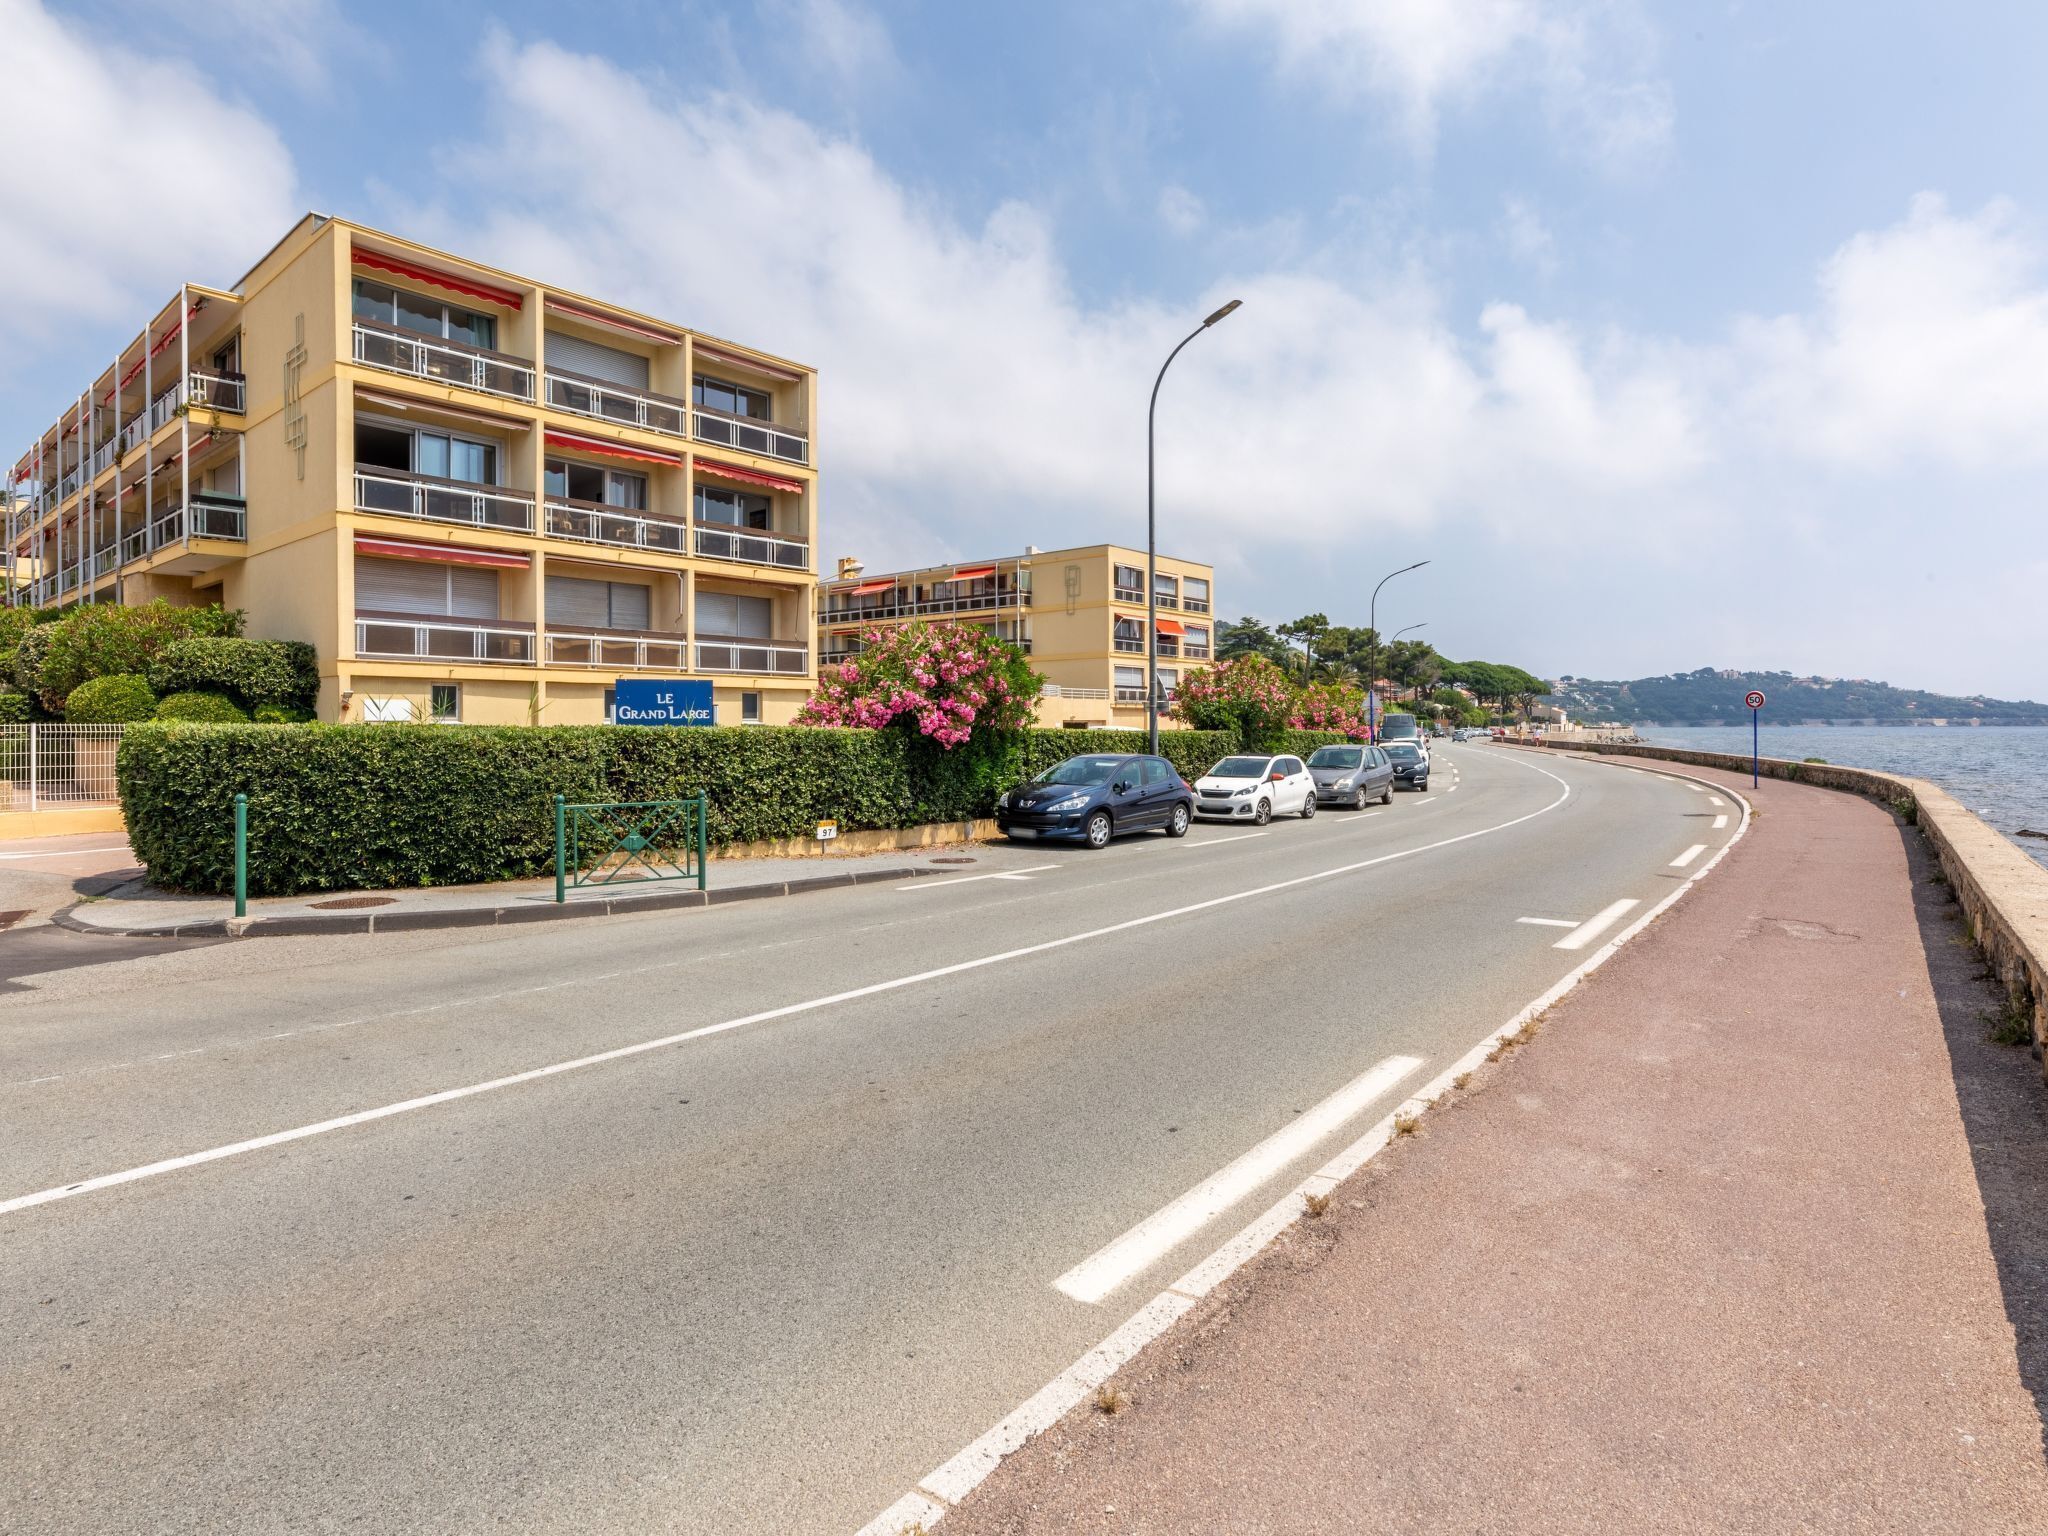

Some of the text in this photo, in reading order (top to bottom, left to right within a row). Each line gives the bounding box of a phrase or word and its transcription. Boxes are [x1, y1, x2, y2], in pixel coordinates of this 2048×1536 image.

[656, 693, 674, 704] LE
[1749, 696, 1761, 704] 50
[618, 705, 710, 720] GRAND LARGE
[822, 828, 832, 837] 97
